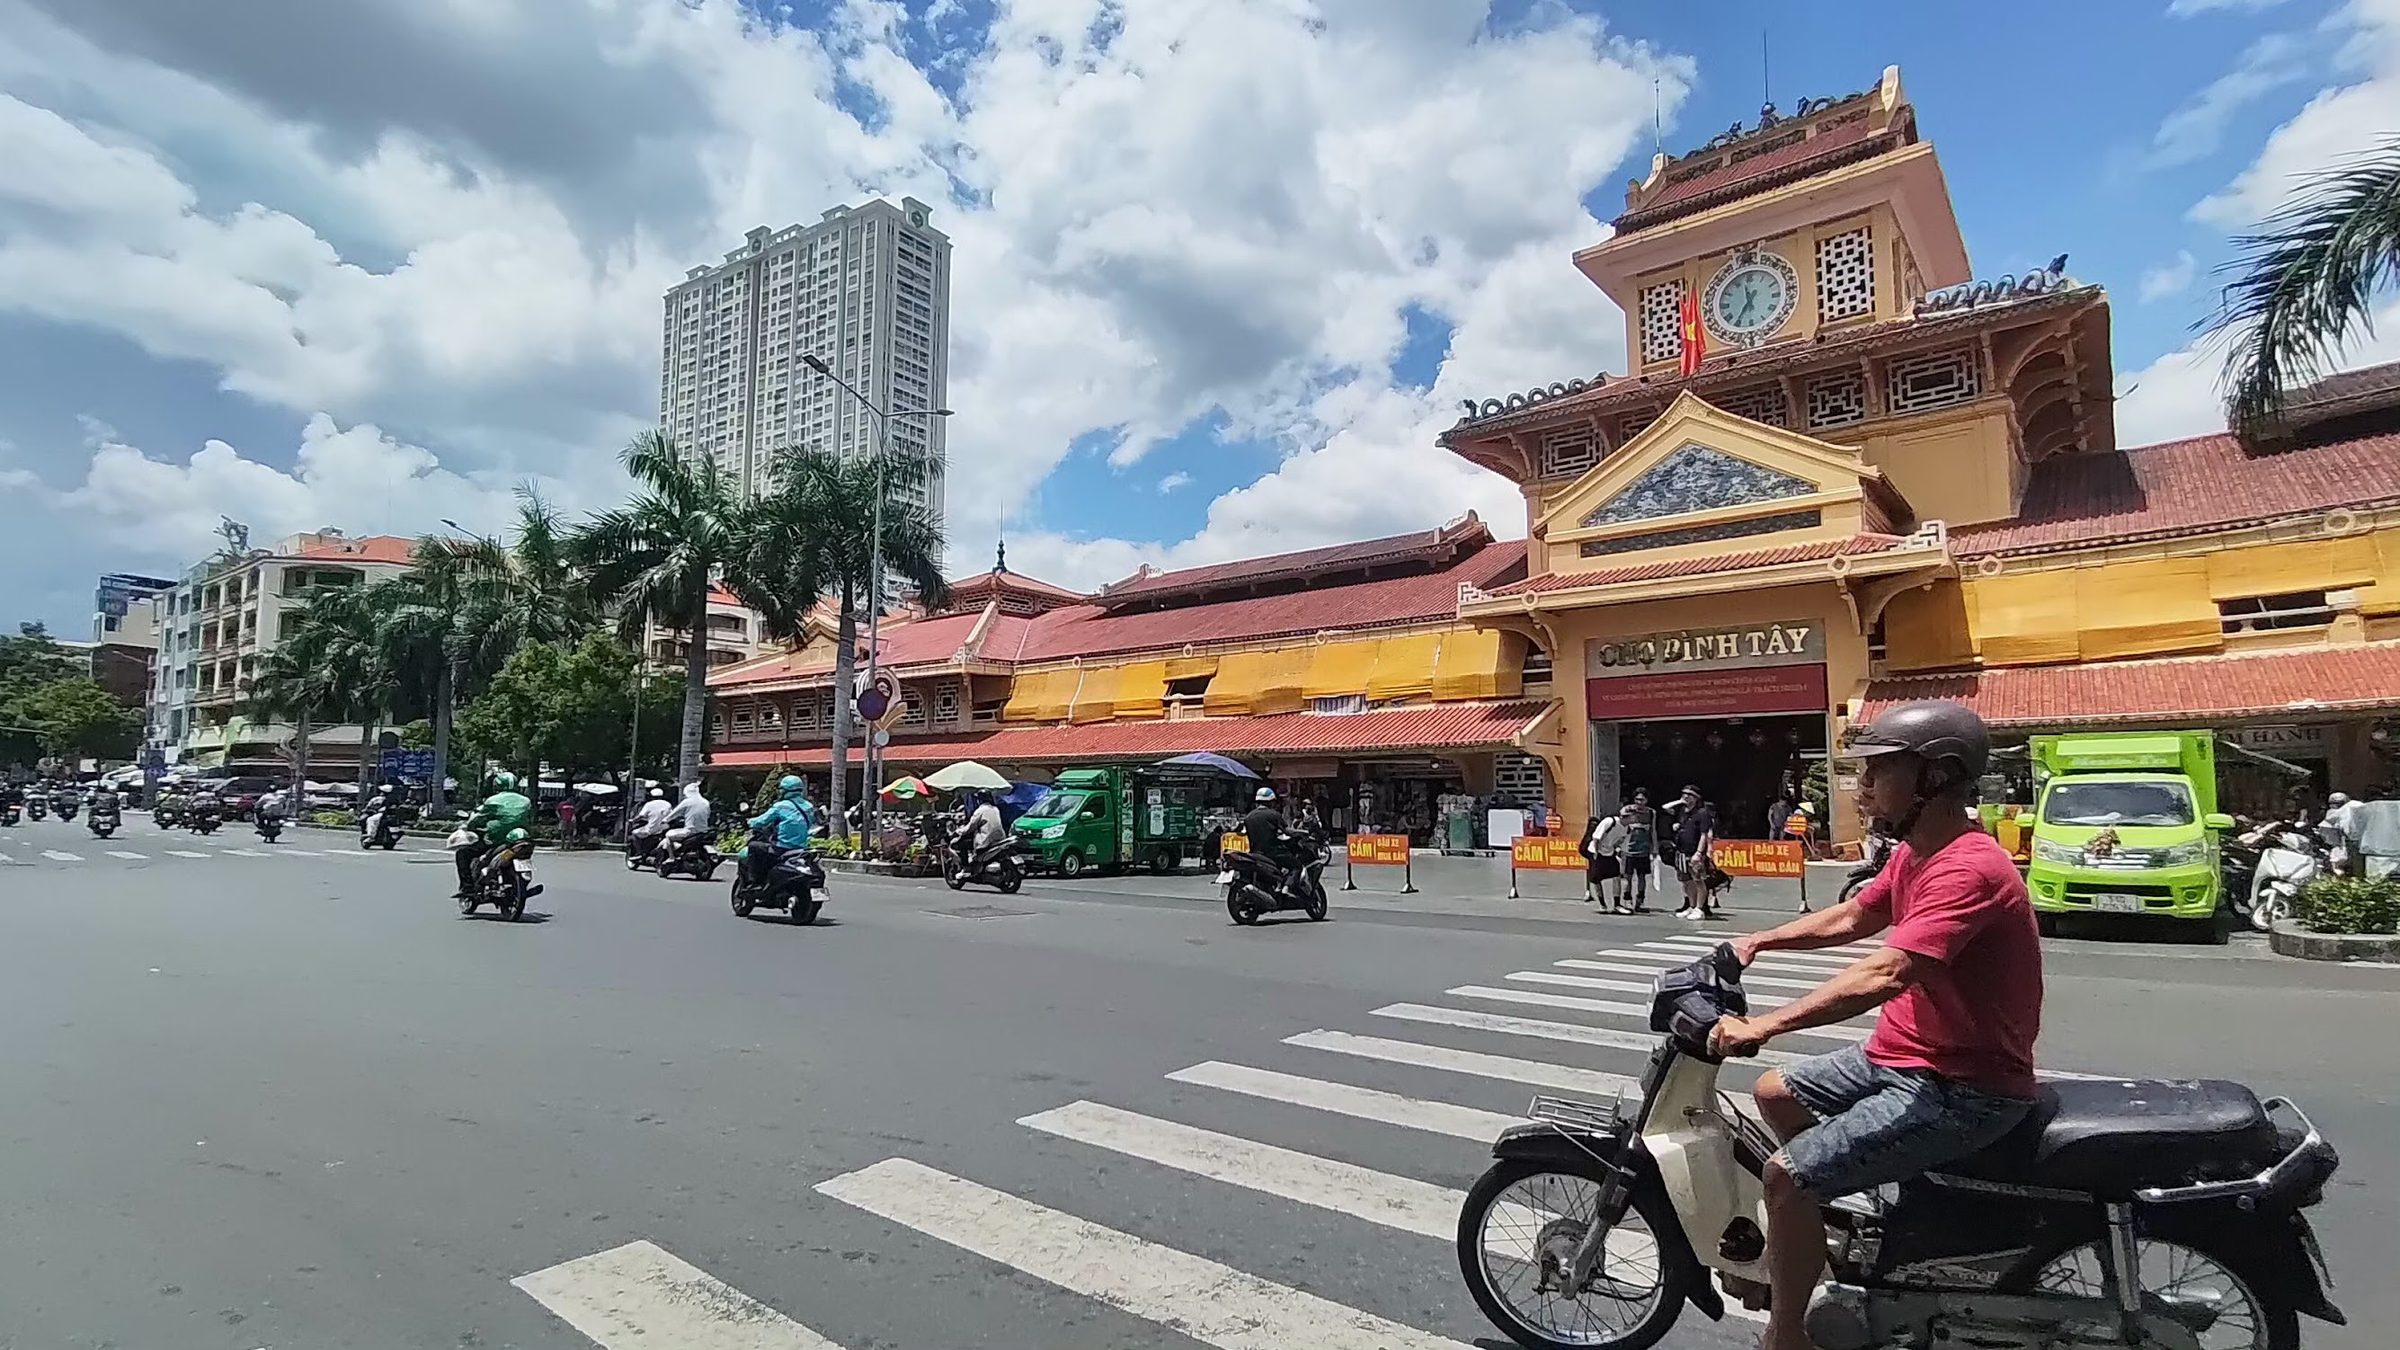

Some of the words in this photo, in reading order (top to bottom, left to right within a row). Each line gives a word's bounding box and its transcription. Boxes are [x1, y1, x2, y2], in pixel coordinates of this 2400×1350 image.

[1599, 638, 1655, 670] CHỢ
[1662, 631, 1740, 662] BÌNH
[1745, 624, 1810, 656] TÂY
[1349, 838, 1373, 857] CẤM
[1514, 841, 1543, 861] CẤM
[1713, 843, 1748, 867] CẤM
[1776, 844, 1790, 855] XE
[1756, 861, 1777, 873] MUA
[1779, 859, 1800, 873] BÁN
